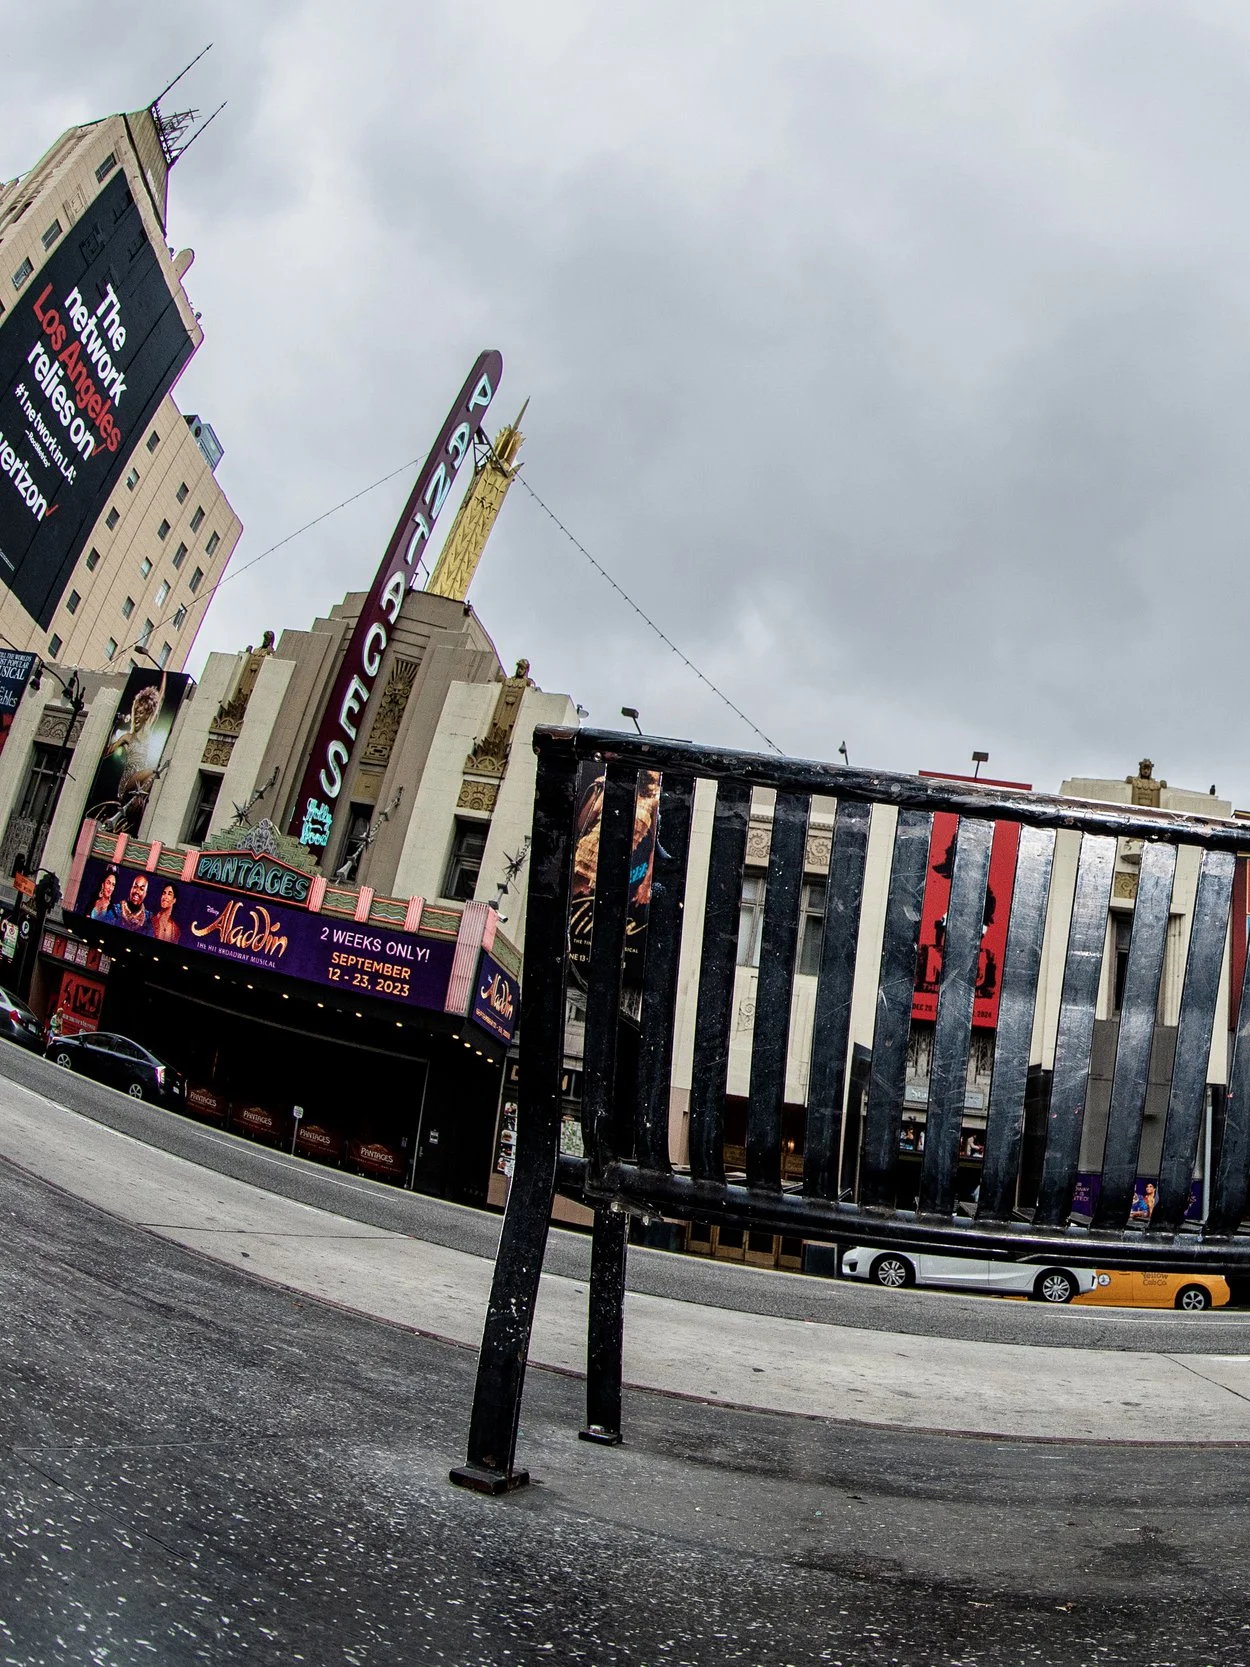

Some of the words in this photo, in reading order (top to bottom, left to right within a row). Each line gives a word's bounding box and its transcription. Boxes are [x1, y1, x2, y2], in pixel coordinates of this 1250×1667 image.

[96, 282, 127, 351] The
[64, 286, 127, 407] network
[33, 282, 67, 351] Los
[58, 340, 121, 452] Angeles
[27, 341, 75, 427] relies
[69, 417, 96, 461] on
[15, 383, 29, 406] #1
[24, 400, 56, 452] network
[52, 445, 64, 467] in
[320, 372, 493, 799] PANTAGES
[198, 857, 309, 900] PANTAGES
[191, 900, 288, 958] Aladdin
[320, 927, 328, 941] 2
[333, 929, 382, 951] WEEKS
[386, 941, 430, 963] ONLY!
[218, 947, 249, 961] BROADWAY
[251, 956, 276, 968] MUSICAL
[331, 952, 411, 980] SEPTEMBER
[327, 967, 341, 981] 12
[352, 973, 371, 989] 23,
[375, 979, 410, 996] 2023
[190, 1091, 217, 1107] PANTAGES
[243, 1110, 272, 1126] PANTAGES
[300, 1128, 331, 1145] PANTAGES
[360, 1146, 394, 1164] PANTAGES
